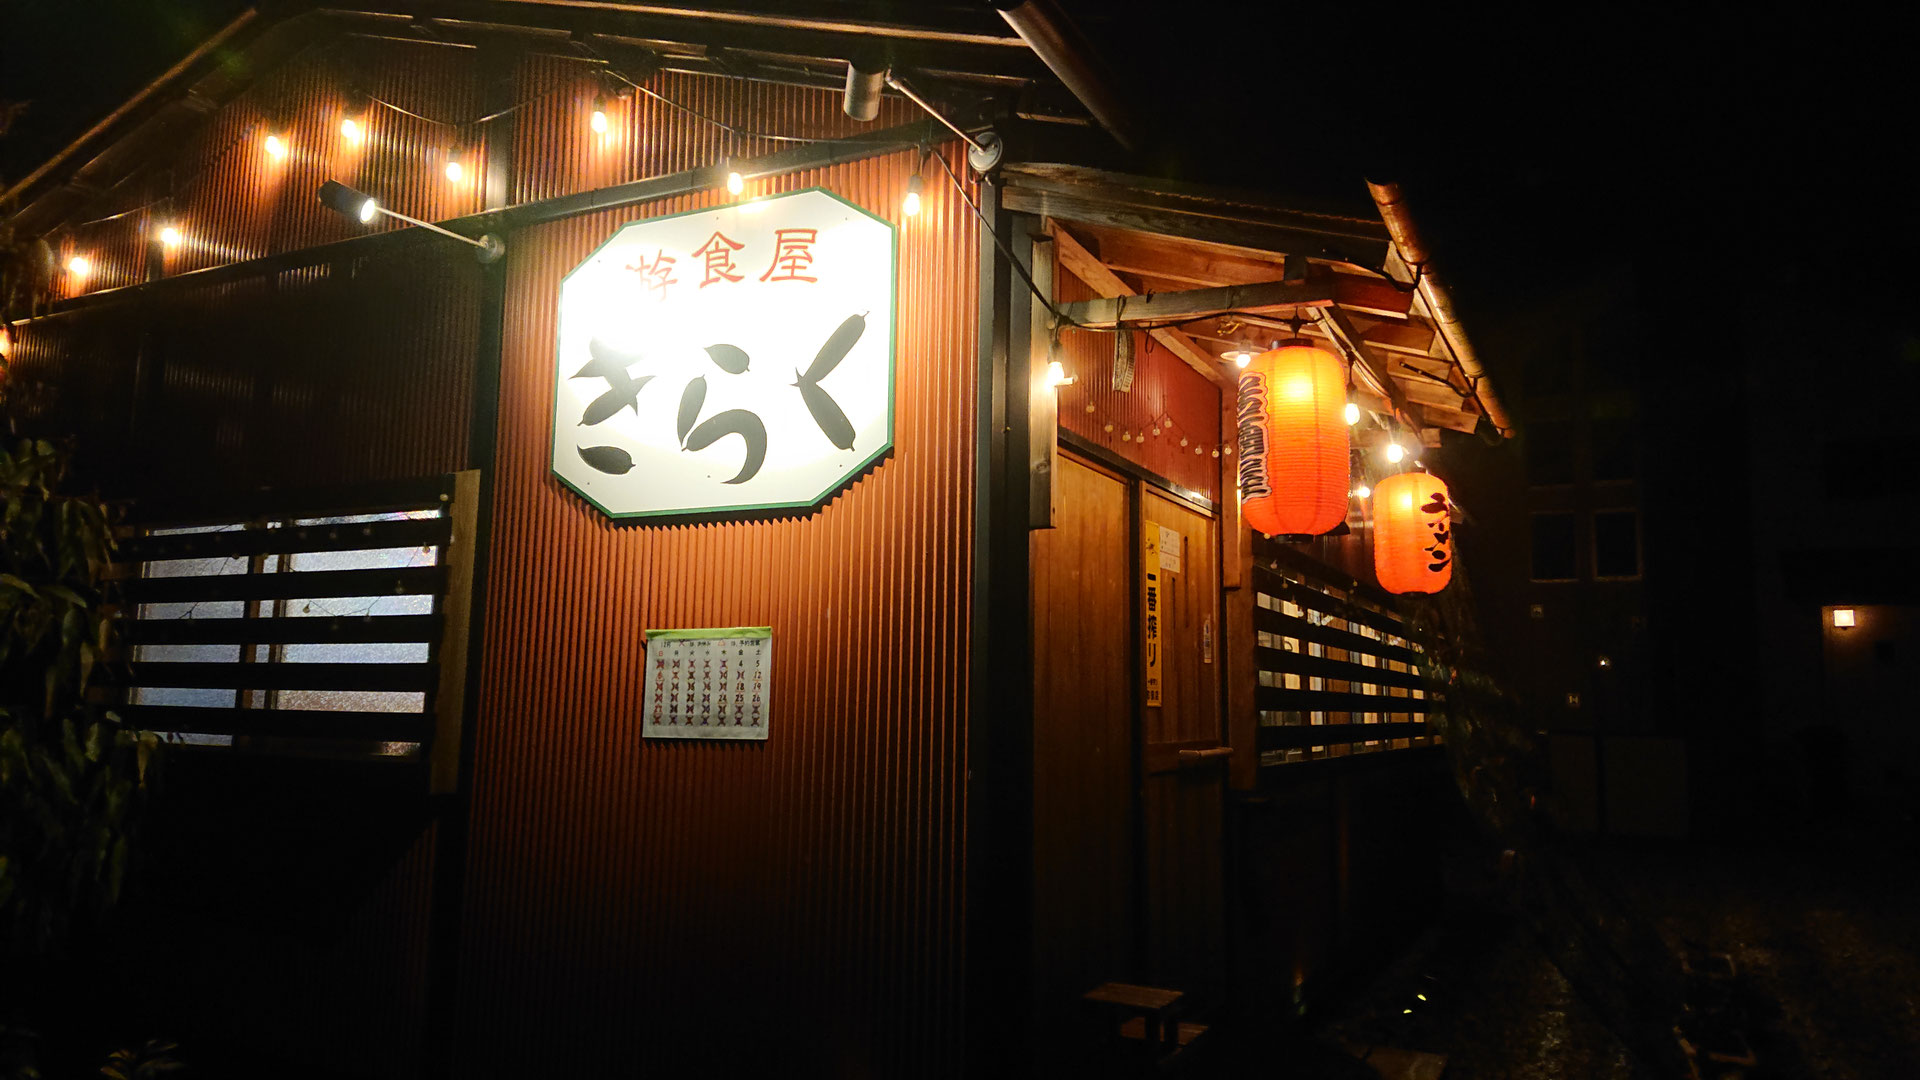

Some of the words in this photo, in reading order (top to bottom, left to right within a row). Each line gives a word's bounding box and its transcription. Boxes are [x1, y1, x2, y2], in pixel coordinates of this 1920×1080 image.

[568, 310, 870, 484] きらく
[1147, 573, 1157, 667] 一番搾り
